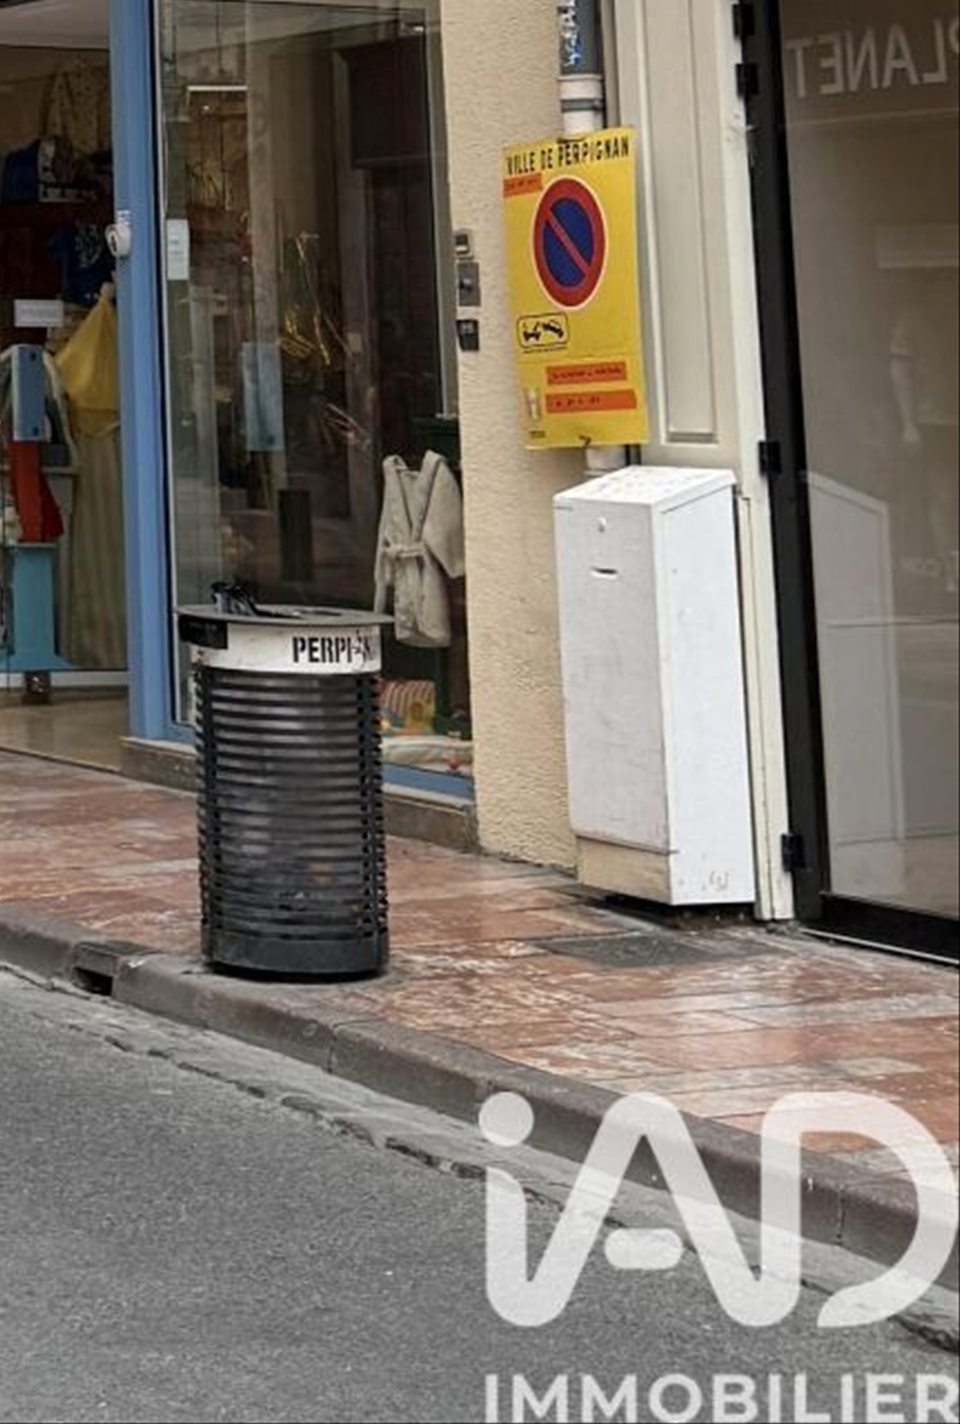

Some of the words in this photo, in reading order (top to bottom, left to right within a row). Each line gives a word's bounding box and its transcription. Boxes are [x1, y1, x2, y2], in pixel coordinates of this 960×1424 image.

[506, 151, 536, 175] VILLE
[541, 147, 554, 170] DE
[558, 136, 629, 167] PERPIGNAN
